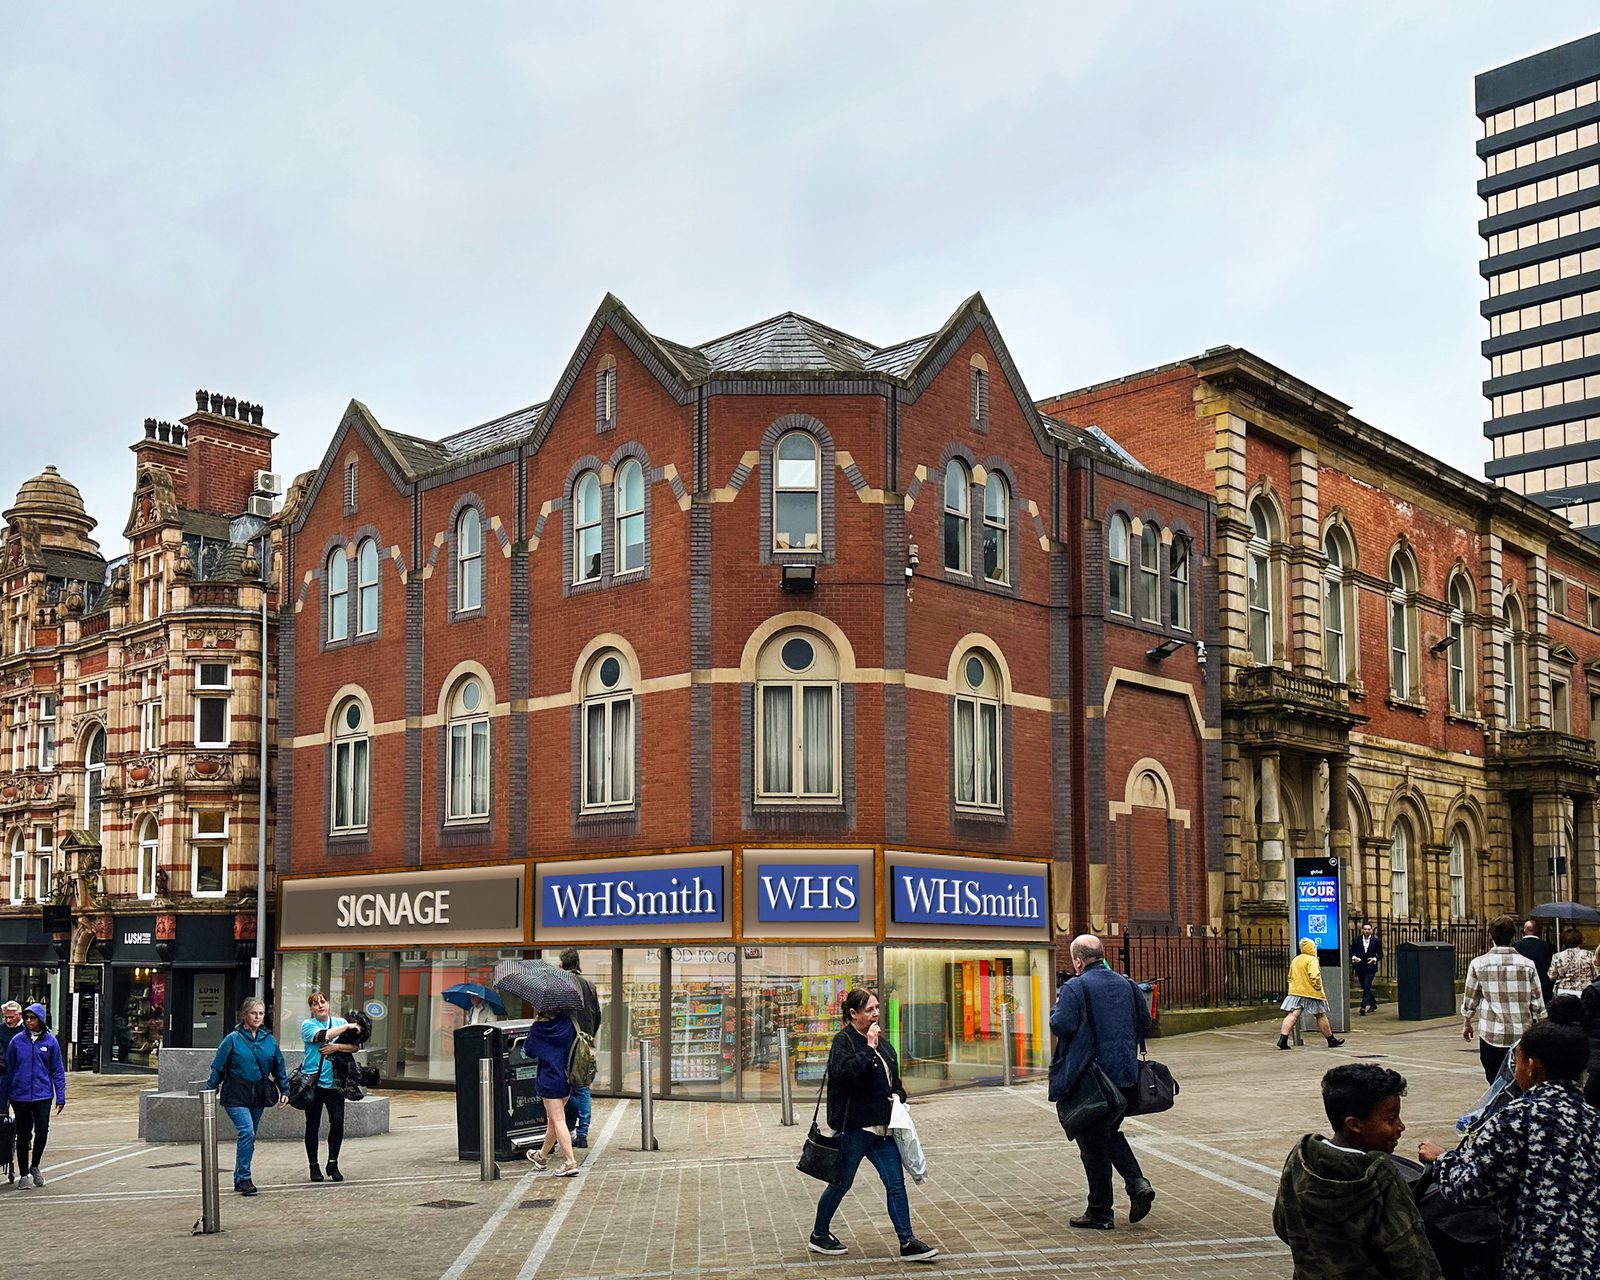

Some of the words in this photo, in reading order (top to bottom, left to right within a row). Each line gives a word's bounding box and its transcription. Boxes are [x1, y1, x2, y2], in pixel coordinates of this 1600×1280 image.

[336, 890, 450, 928] SIGNAGE
[550, 877, 717, 918] WHSmith
[760, 875, 857, 911] WHS
[901, 874, 1040, 919] WHSmith
[1299, 886, 1335, 896] YOUR
[124, 932, 142, 945] LUSH
[717, 951, 737, 964] GO
